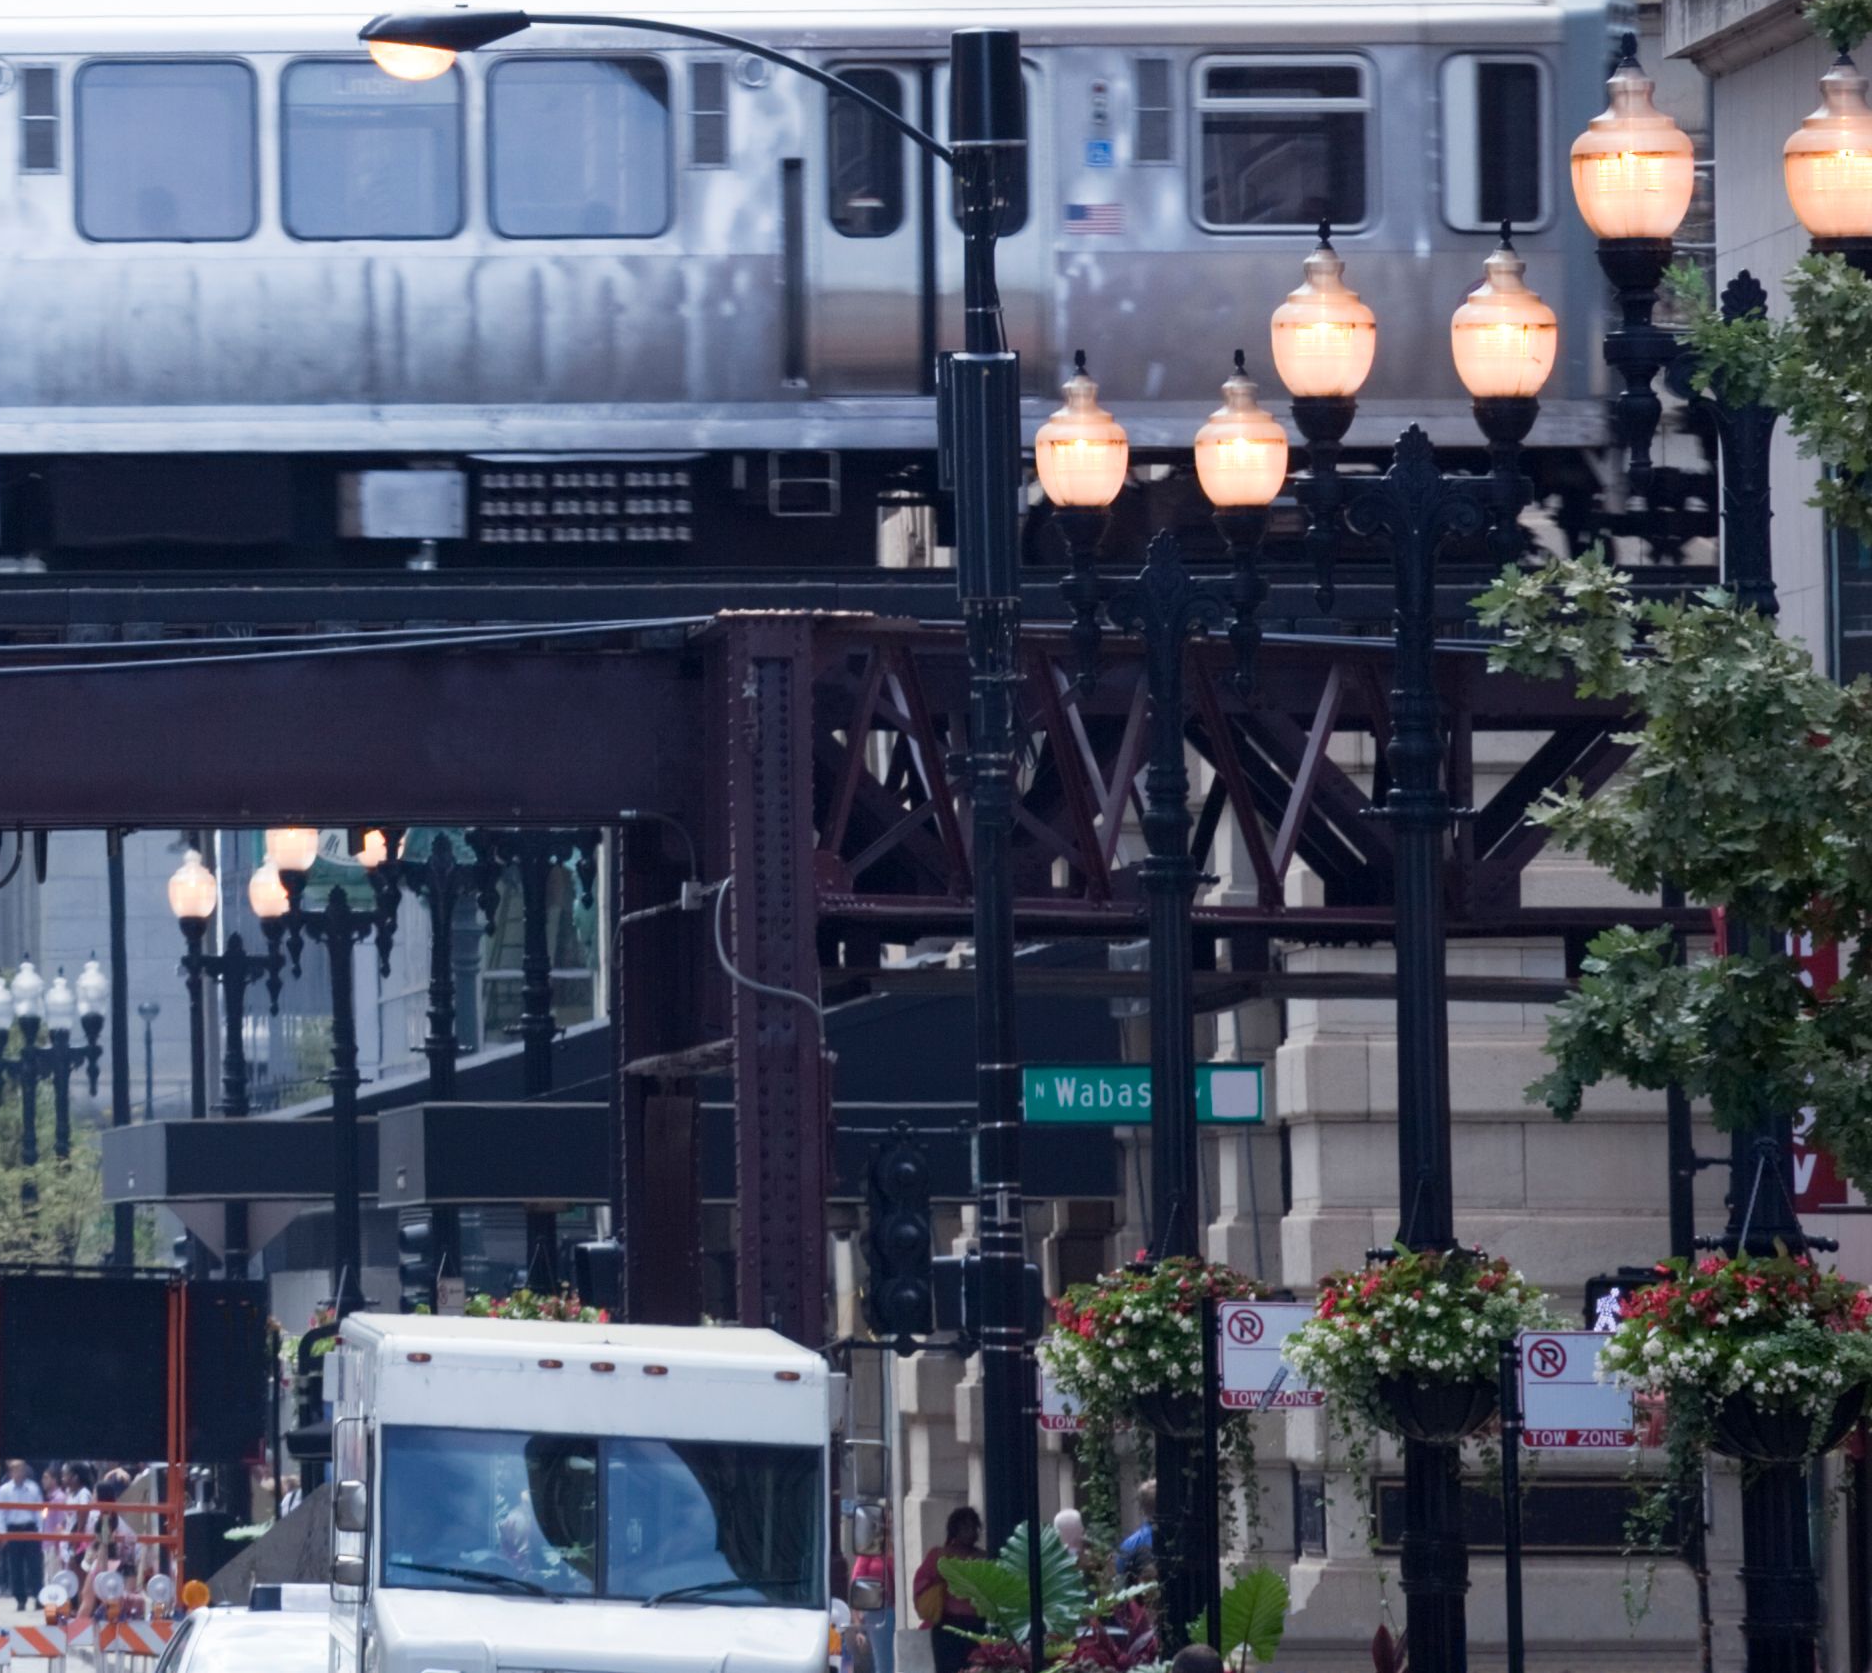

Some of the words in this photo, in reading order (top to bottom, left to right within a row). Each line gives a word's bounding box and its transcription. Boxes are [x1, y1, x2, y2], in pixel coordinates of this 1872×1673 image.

[1035, 1082, 1045, 1099] N
[1054, 1077, 1152, 1108] Wabas
[1229, 1391, 1263, 1405] TOW
[1272, 1392, 1316, 1405] ZONE
[1047, 1416, 1077, 1428] TOW
[1530, 1431, 1567, 1445] TOW
[1577, 1430, 1627, 1445] ZONE
